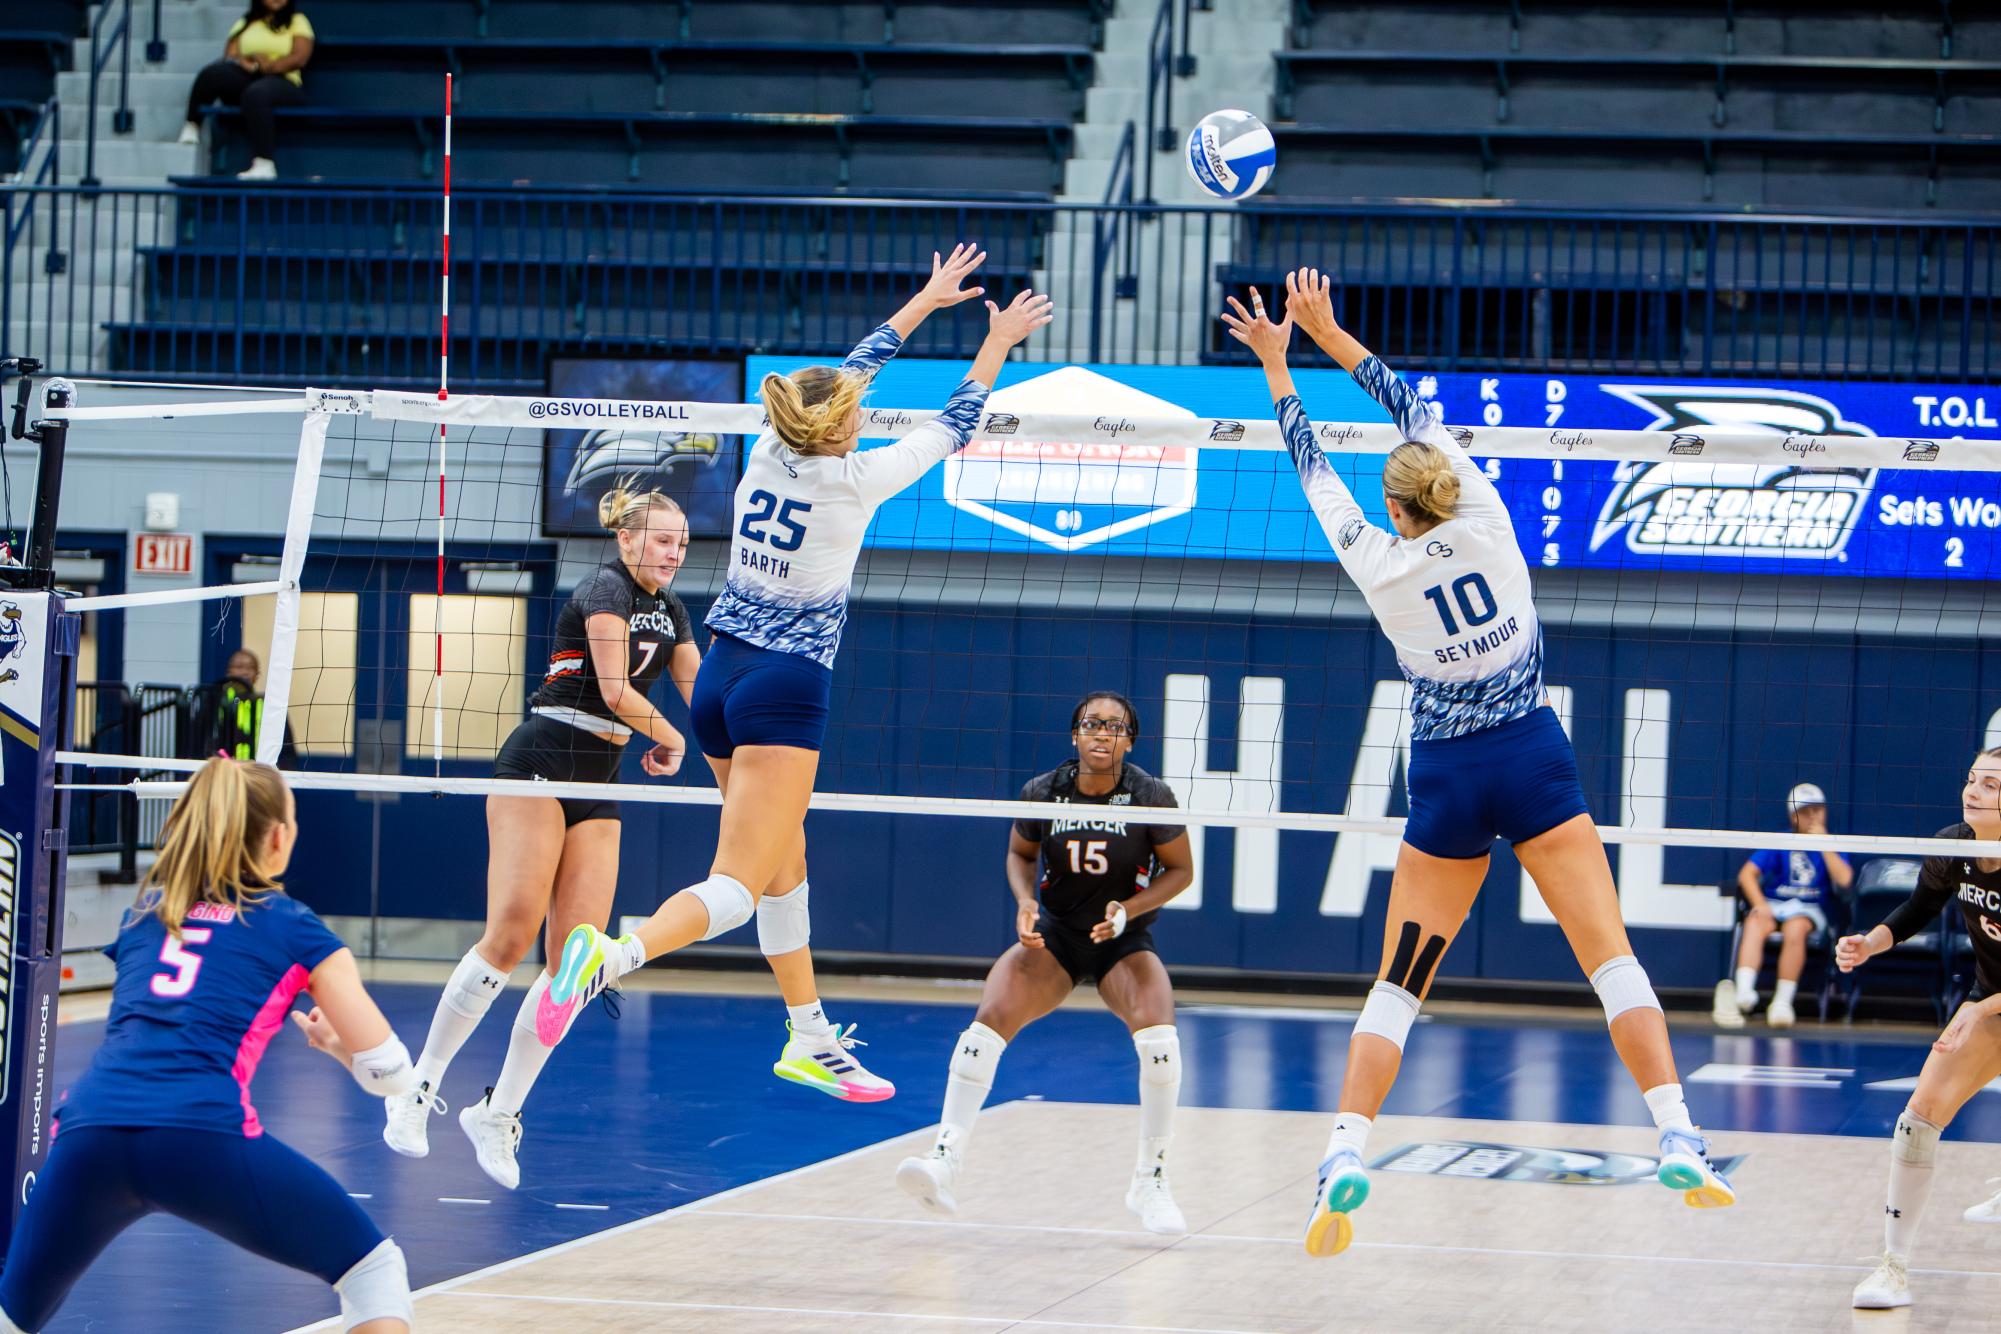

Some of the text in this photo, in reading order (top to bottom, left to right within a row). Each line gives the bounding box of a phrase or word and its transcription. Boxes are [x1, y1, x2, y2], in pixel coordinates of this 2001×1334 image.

[1203, 133, 1229, 183] molten
[328, 393, 354, 401] Senoh
[1481, 378, 1500, 401] K
[1546, 380, 1567, 402] D
[528, 401, 690, 420] @GSVOLLEYBALL
[870, 410, 912, 431] Eagles
[1545, 404, 1565, 427] 7
[1093, 416, 1136, 437] Eagles
[1320, 424, 1363, 445] Eagles
[1550, 430, 1593, 452] Eagles
[1782, 437, 1826, 458] Eagles
[1654, 488, 1850, 522] GEORGIA
[1878, 494, 1944, 527] Sets
[739, 489, 812, 552] 25
[1541, 515, 1561, 538] 7
[1637, 515, 1840, 549] SOUTHERN
[143, 540, 188, 570] EXIT
[741, 547, 790, 579] BARTH
[1541, 543, 1560, 567] 5
[1944, 537, 1965, 567] 2
[1424, 572, 1499, 637] 10
[1434, 615, 1520, 664] SEYMOUR
[629, 641, 659, 677] 7
[1050, 818, 1128, 837] MERCER
[1066, 840, 1109, 875] 15
[151, 927, 212, 997] 5
[31, 993, 50, 1156] sports imports
